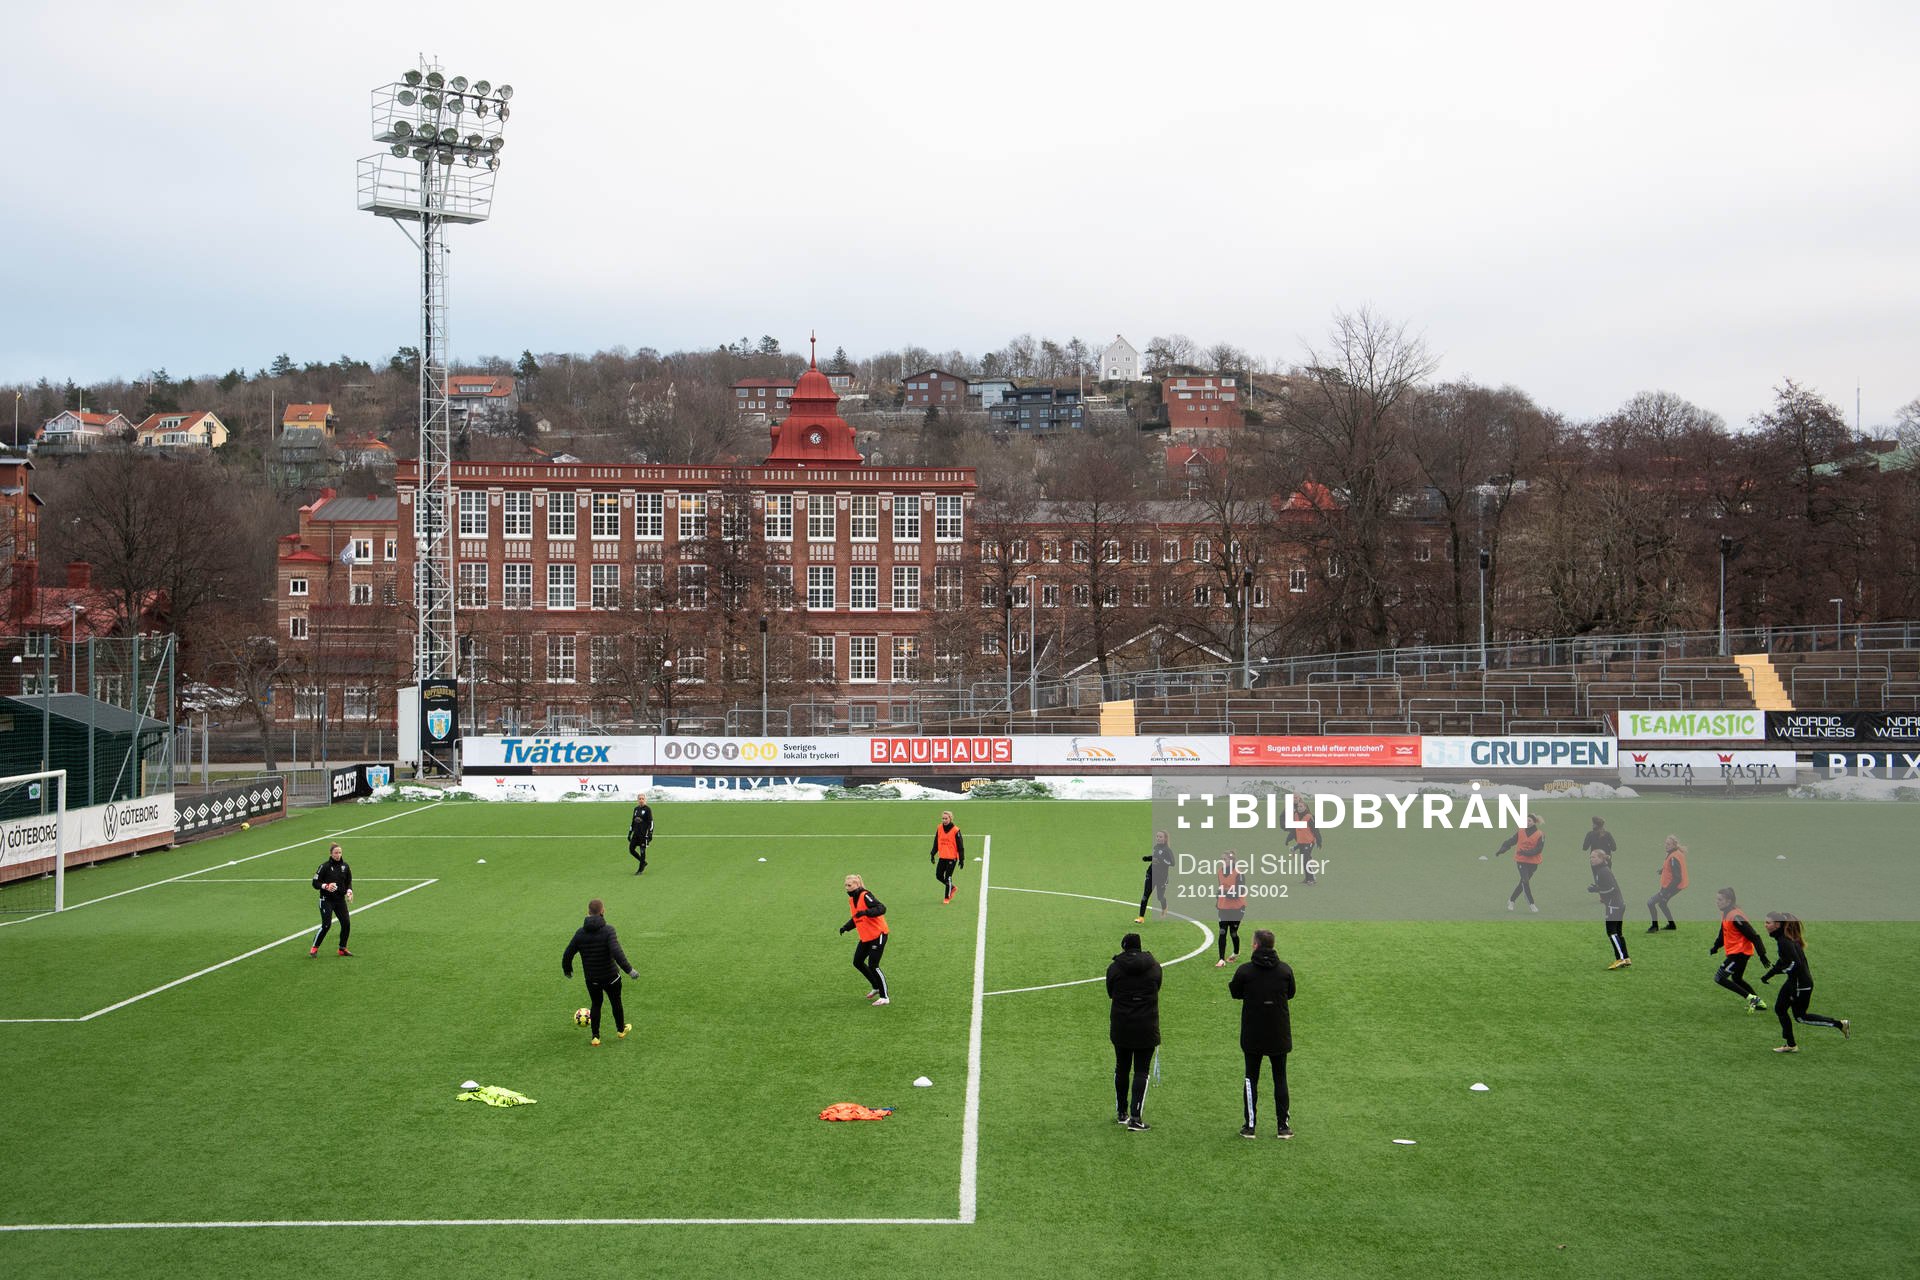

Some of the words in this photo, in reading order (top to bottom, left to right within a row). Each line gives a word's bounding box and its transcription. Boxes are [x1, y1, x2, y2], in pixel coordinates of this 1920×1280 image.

[1630, 714, 1755, 736] TEAMTASTIC
[1787, 716, 1841, 727] NORDIC
[1886, 716, 1920, 727] NOR
[1774, 727, 1856, 738] WELLNESS
[500, 738, 611, 764] Tvättex
[783, 743, 817, 752] Sveriges
[873, 740, 1010, 760] BAUHAUS
[1266, 744, 1290, 753] Sugen
[1291, 744, 1301, 753] på
[1314, 744, 1328, 752] mål
[1329, 744, 1346, 752] efter
[1348, 744, 1384, 752] matchen?
[1471, 741, 1609, 766] GRUPPEN
[809, 752, 840, 760] tryckeri
[1634, 763, 1695, 778] RASTA
[1720, 763, 1781, 779] RASTA
[333, 771, 357, 798] SELECT
[120, 804, 158, 826] GÖTEBORG
[8, 823, 57, 848] GÖTEBORG
